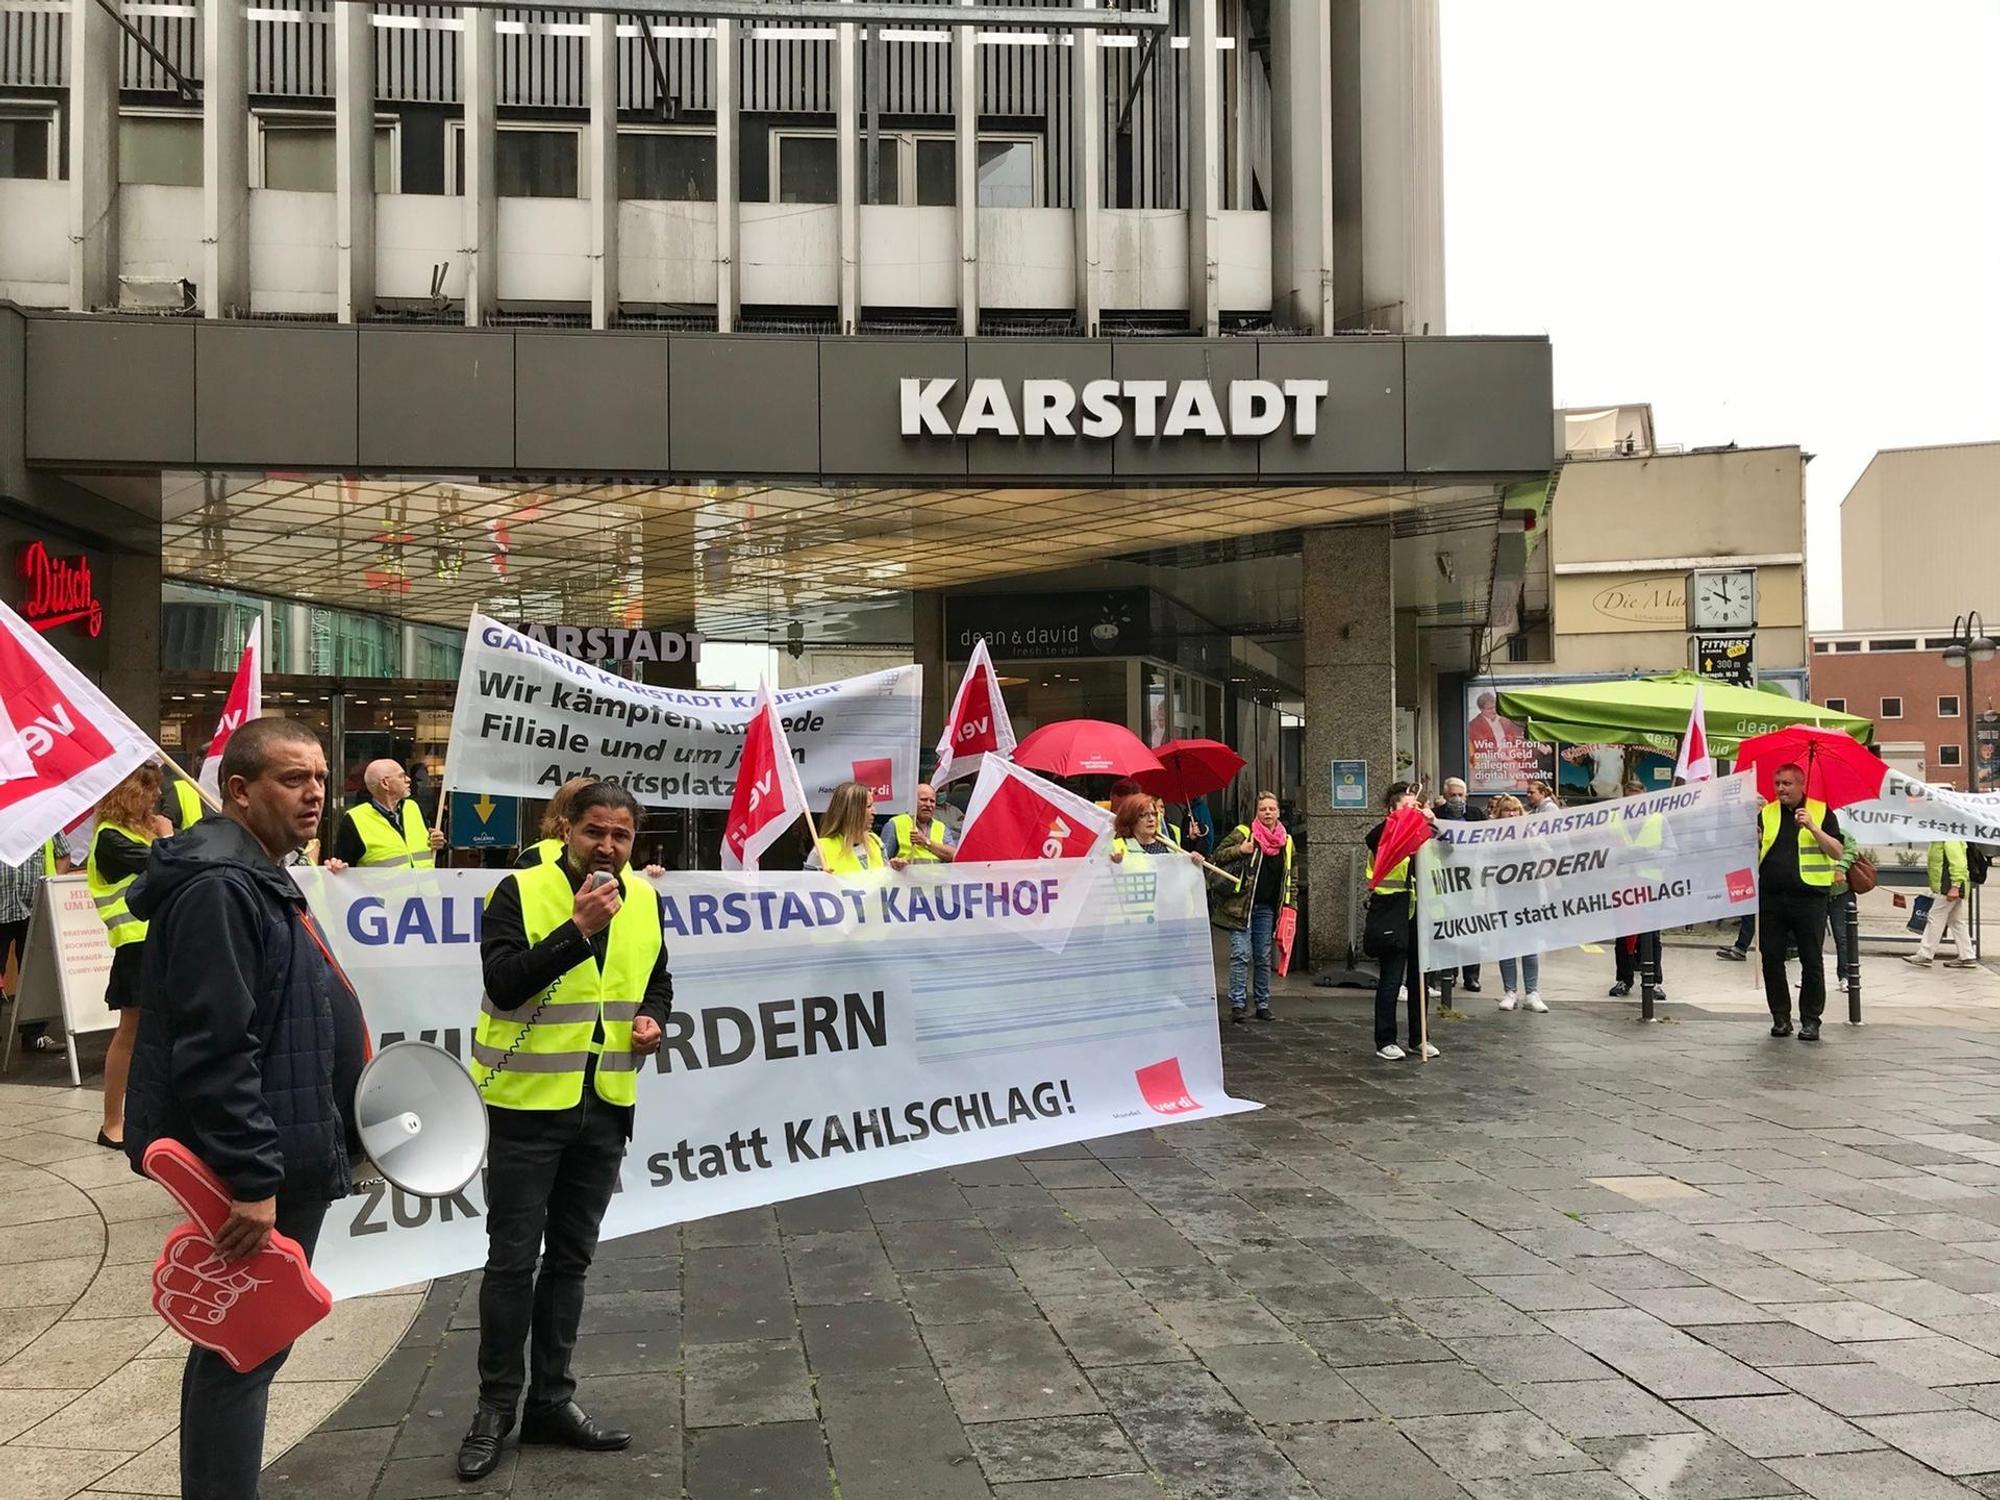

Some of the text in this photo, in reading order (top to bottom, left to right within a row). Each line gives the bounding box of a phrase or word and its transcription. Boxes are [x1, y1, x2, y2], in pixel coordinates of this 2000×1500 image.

[900, 379, 1329, 438] KARSTADT
[26, 540, 93, 617] Ditsch
[1604, 592, 1638, 609] Die
[508, 622, 705, 664] ARSTADT
[961, 625, 1079, 646] dean & david
[1701, 640, 1751, 648] FITNESS
[482, 626, 843, 708] GALERIA KARSTADT KUFHOF
[1717, 660, 1733, 669] 300
[479, 670, 541, 703] Wir
[550, 682, 702, 732] kämpfen
[781, 710, 825, 733] ede
[480, 712, 589, 753] Filiale
[600, 738, 667, 762] und
[674, 748, 723, 764] um
[1473, 739, 1494, 749] Wie
[1474, 749, 1533, 759] online Geld
[1474, 759, 1539, 771] anlegen und
[1475, 770, 1507, 780] digital
[1437, 790, 1702, 845] ALERIA KARSTADT KAUFHOF
[1847, 808, 1913, 826] KUNFT
[1917, 819, 1969, 836] statt
[70, 889, 91, 900] HIE
[1431, 848, 1611, 896] WIR FORDERN
[663, 890, 867, 937] ARSTADT
[882, 878, 1059, 922] KAUFHOF
[1433, 878, 1692, 941] ZUKUNFT statt KAHLSCHLAG!
[640, 990, 889, 1076] RDERN
[646, 1126, 773, 1188] statt
[784, 1079, 1076, 1164] KAHLSCHLAG!
